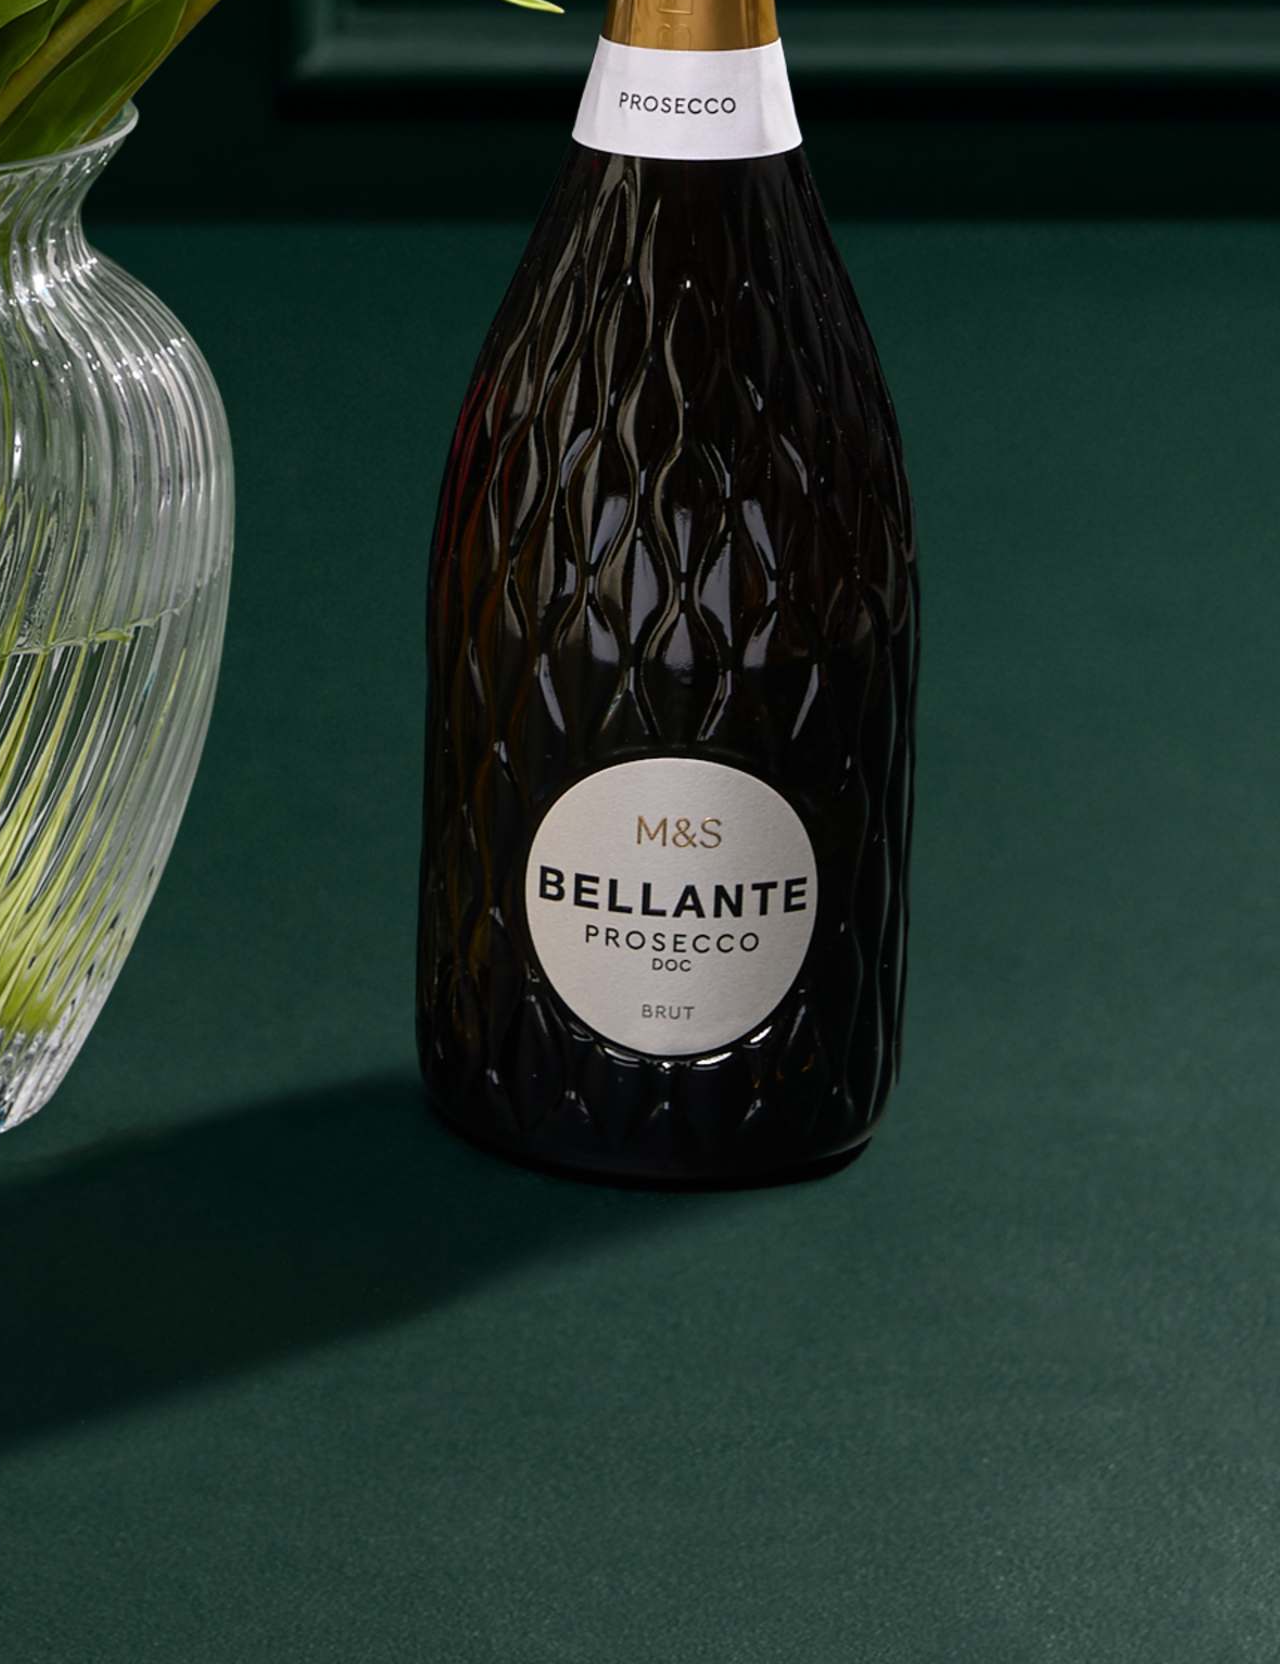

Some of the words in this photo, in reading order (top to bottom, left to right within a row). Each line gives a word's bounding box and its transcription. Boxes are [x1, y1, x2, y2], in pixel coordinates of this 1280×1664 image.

[619, 92, 736, 114] PROSECCO
[637, 816, 722, 849] M&S
[539, 865, 808, 918] BELLANTE
[586, 925, 759, 953] PROSECCO
[652, 958, 691, 972] DOC
[642, 1004, 695, 1020] BRUT
